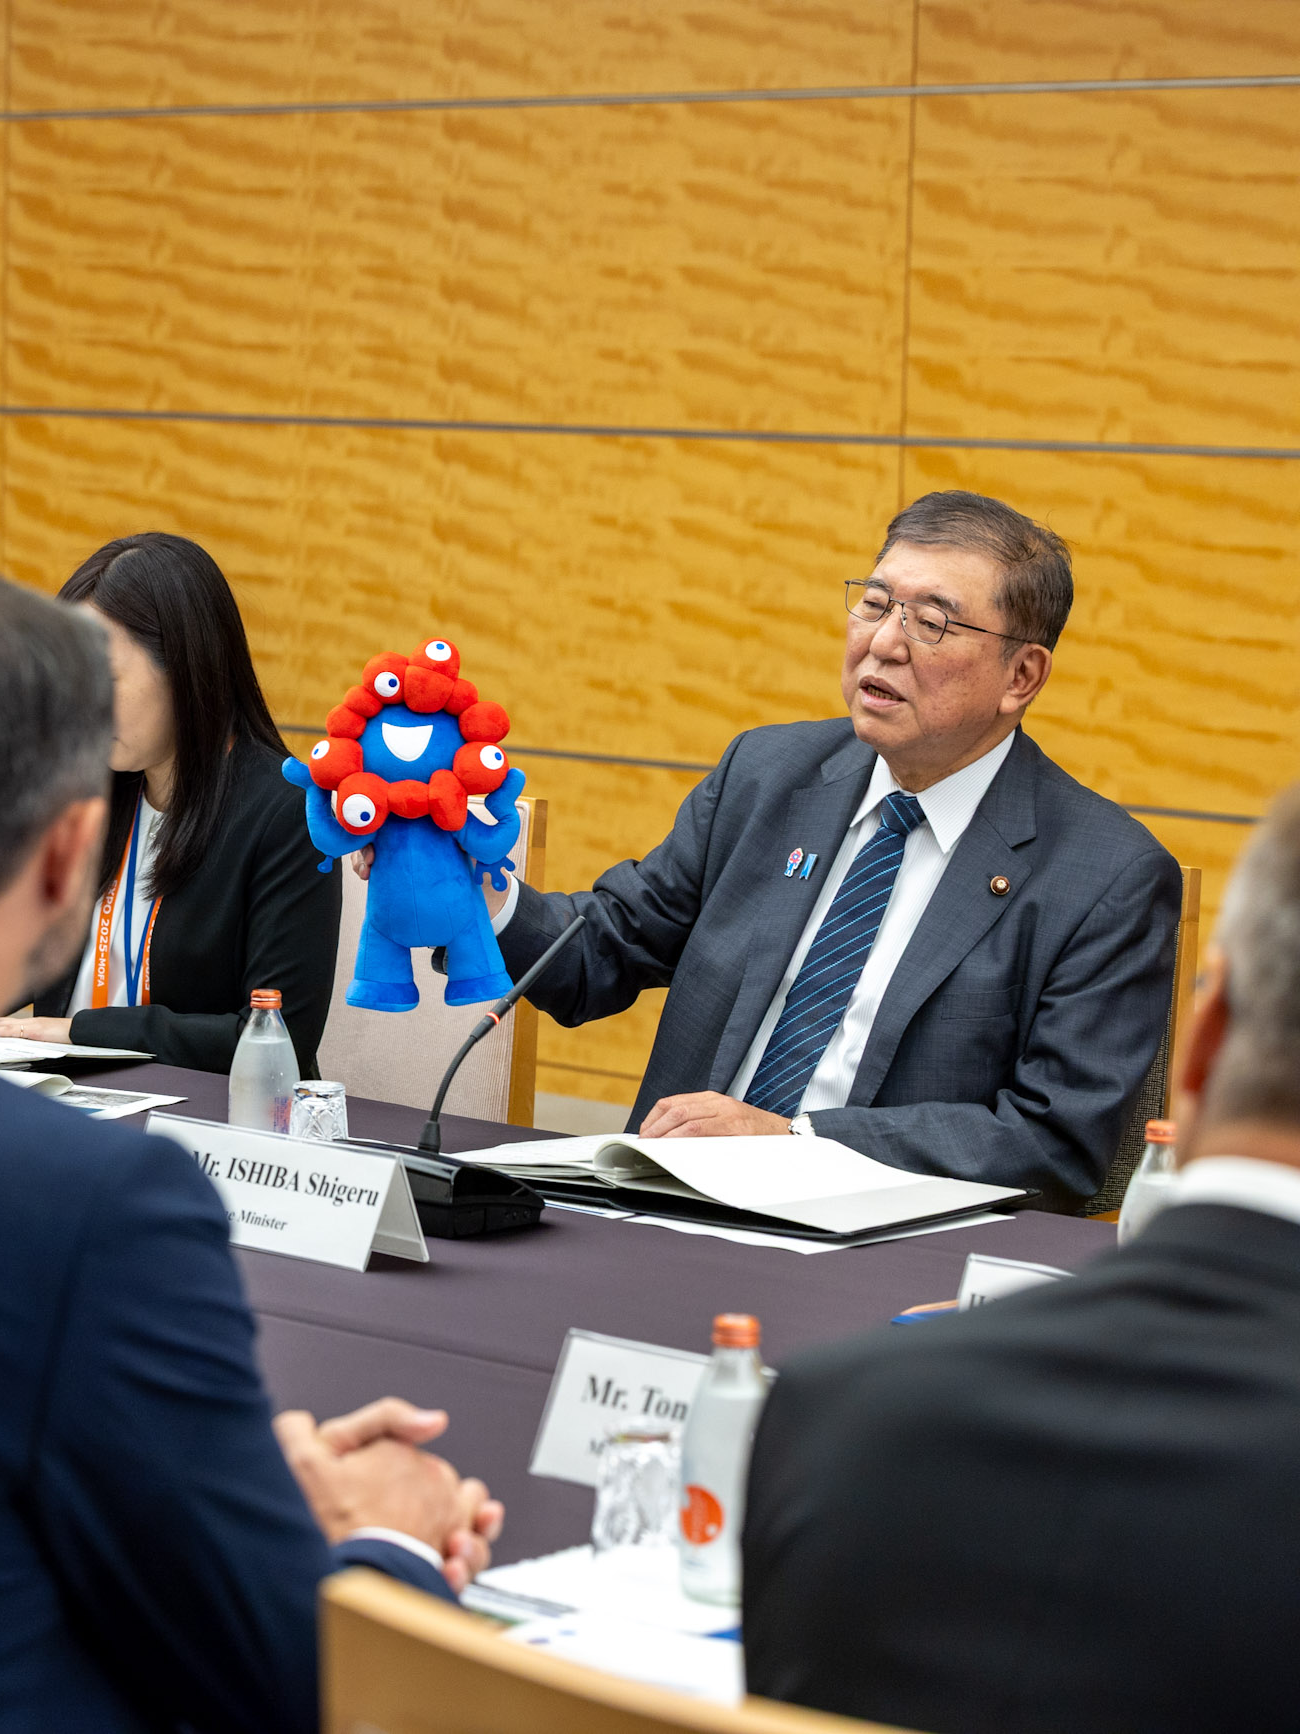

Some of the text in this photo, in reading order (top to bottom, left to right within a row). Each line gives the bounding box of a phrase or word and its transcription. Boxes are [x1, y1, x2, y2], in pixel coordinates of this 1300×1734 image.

[96, 880, 118, 987] EXPO 2025-MOFA
[226, 1157, 300, 1192] ISHIBA
[304, 1172, 380, 1207] Shigeru
[238, 1209, 288, 1232] Minister
[581, 1374, 628, 1411] Mr.
